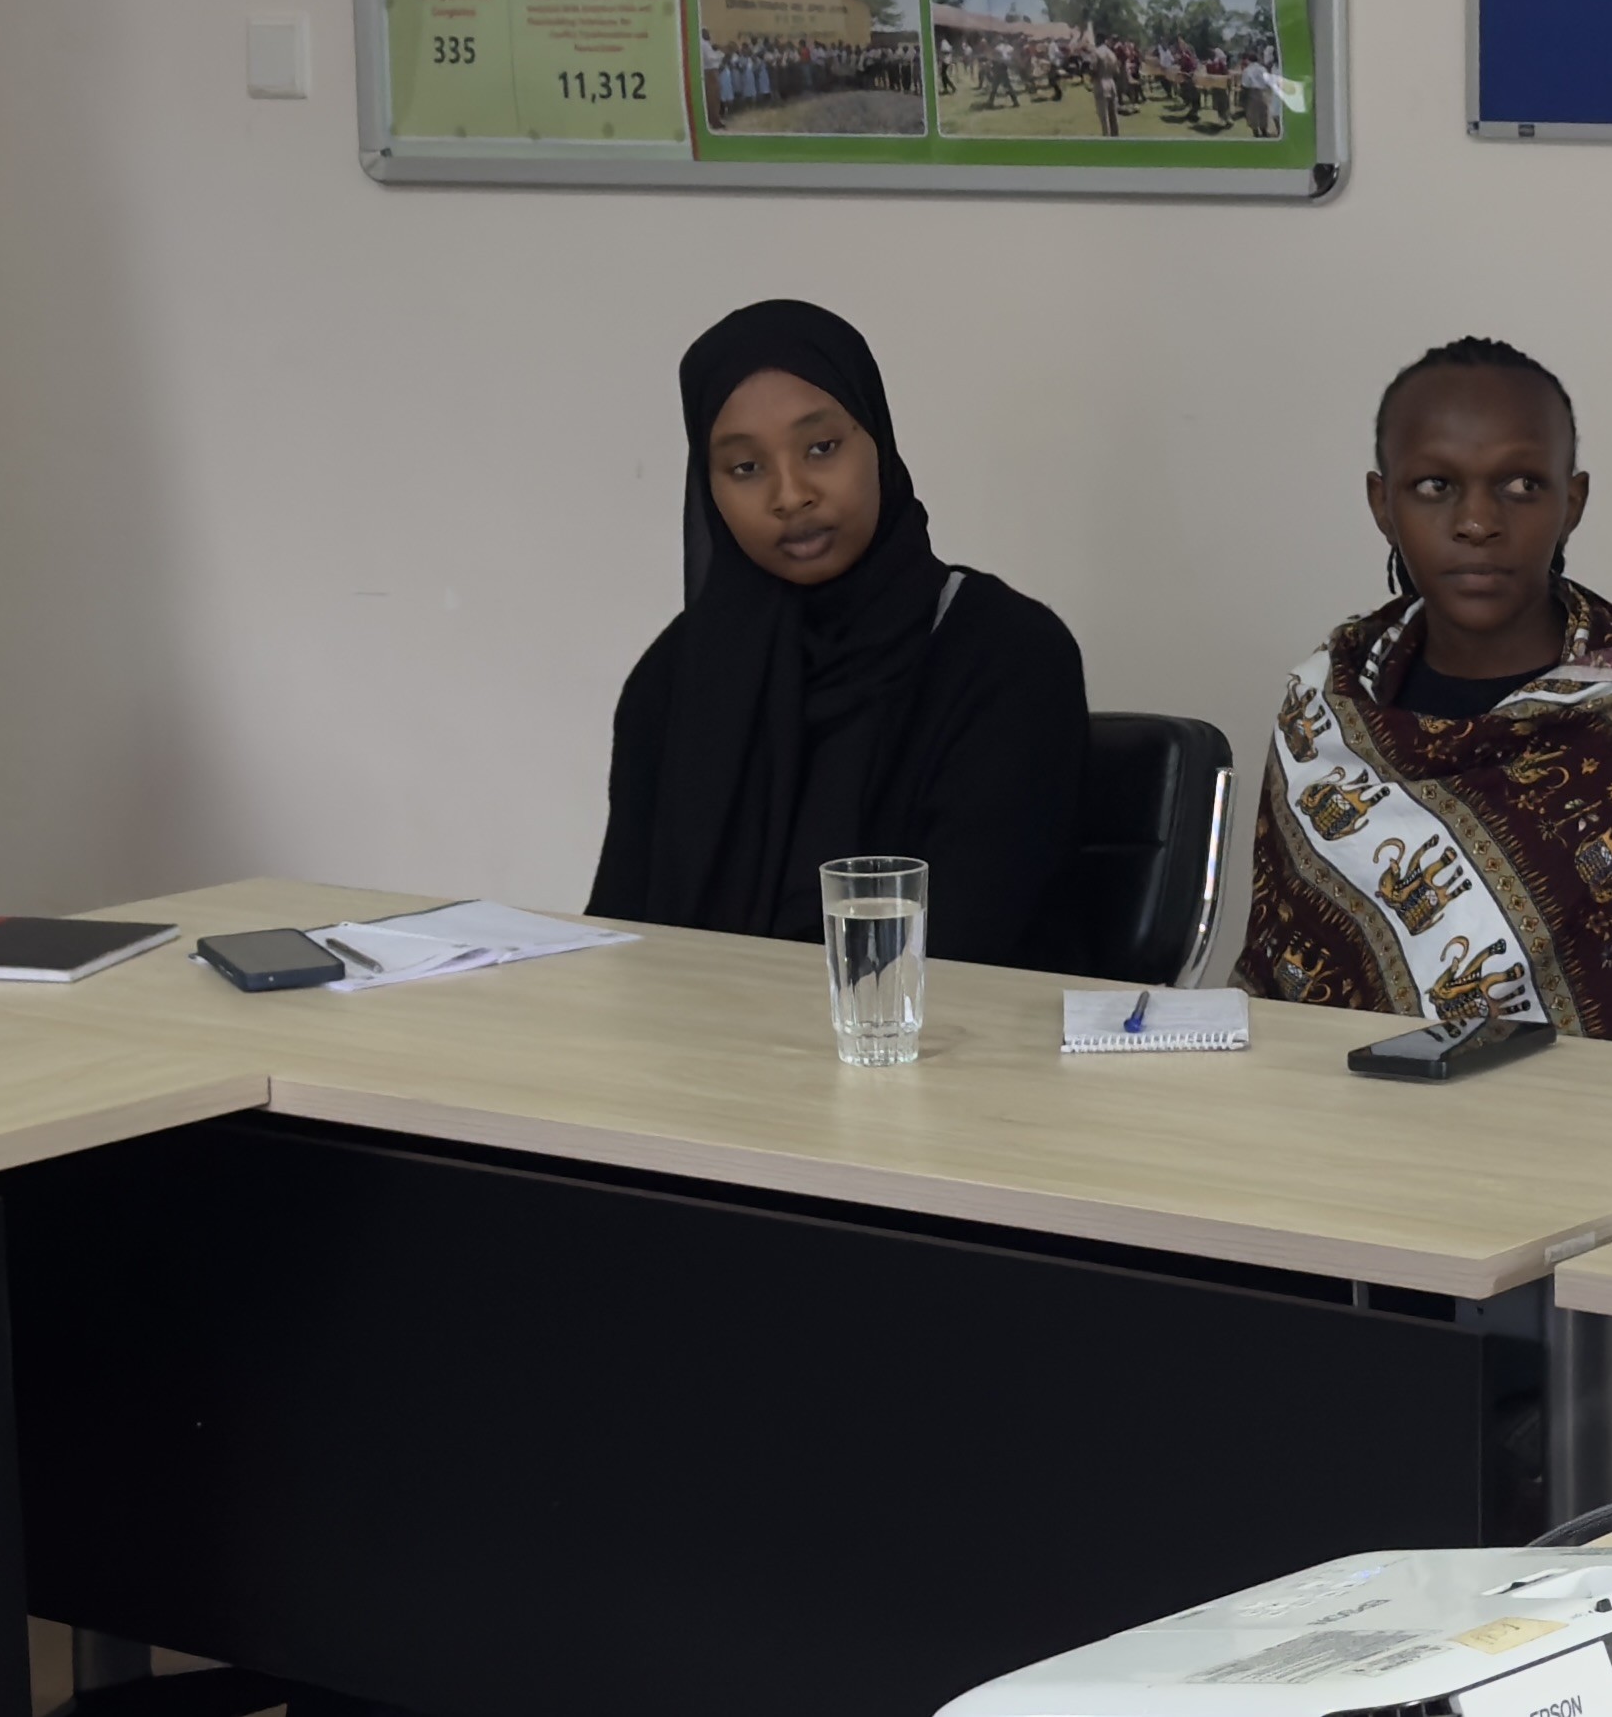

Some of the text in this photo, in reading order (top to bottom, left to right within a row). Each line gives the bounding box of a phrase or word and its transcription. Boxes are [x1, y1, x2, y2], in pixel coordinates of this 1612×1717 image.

[433, 35, 477, 65] 335
[557, 70, 648, 104] 11,312
[1529, 1694, 1583, 1717] PSON
